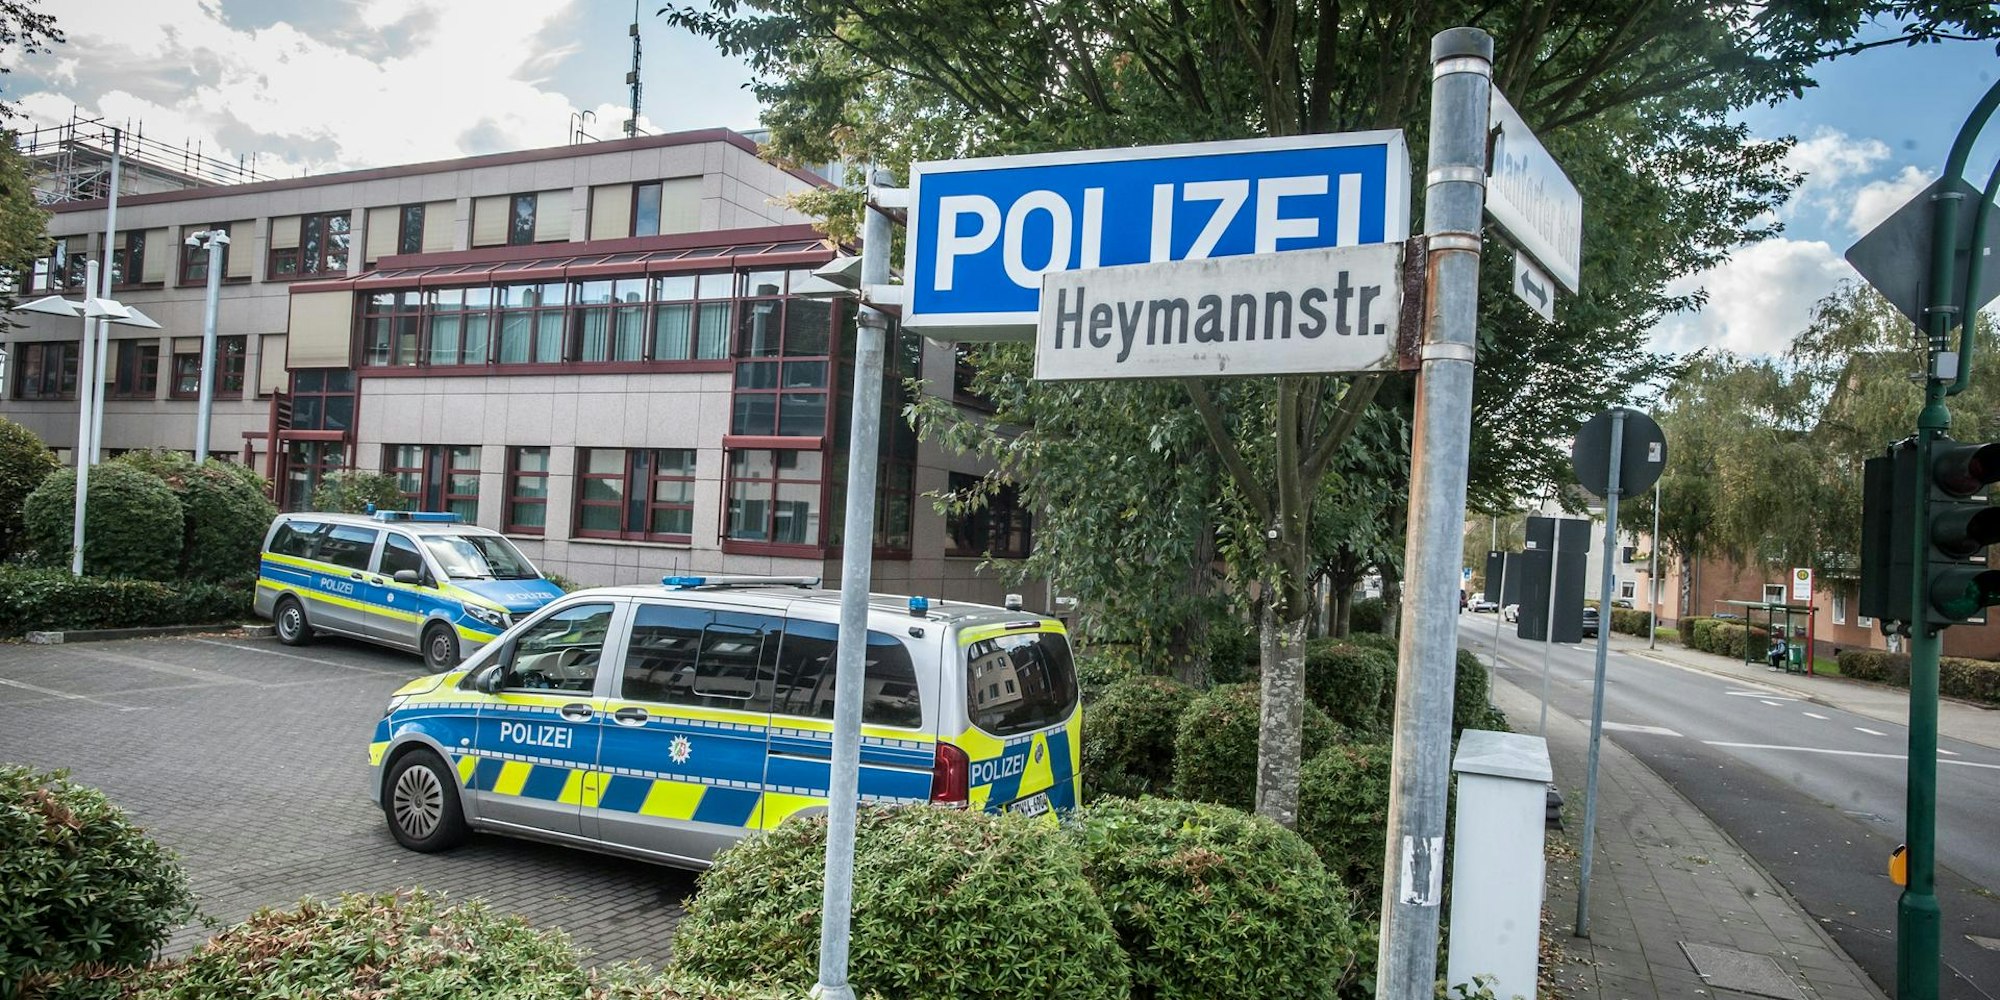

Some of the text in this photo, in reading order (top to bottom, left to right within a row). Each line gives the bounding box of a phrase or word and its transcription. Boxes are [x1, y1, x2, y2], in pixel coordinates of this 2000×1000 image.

[933, 172, 1362, 292] POLIZEI
[1054, 270, 1387, 363] Heymannstr.
[320, 577, 354, 595] POLIZEI
[505, 592, 556, 600] POLIZEI
[500, 721, 573, 749] POLIZEI
[971, 754, 1024, 785] POLIZEI
